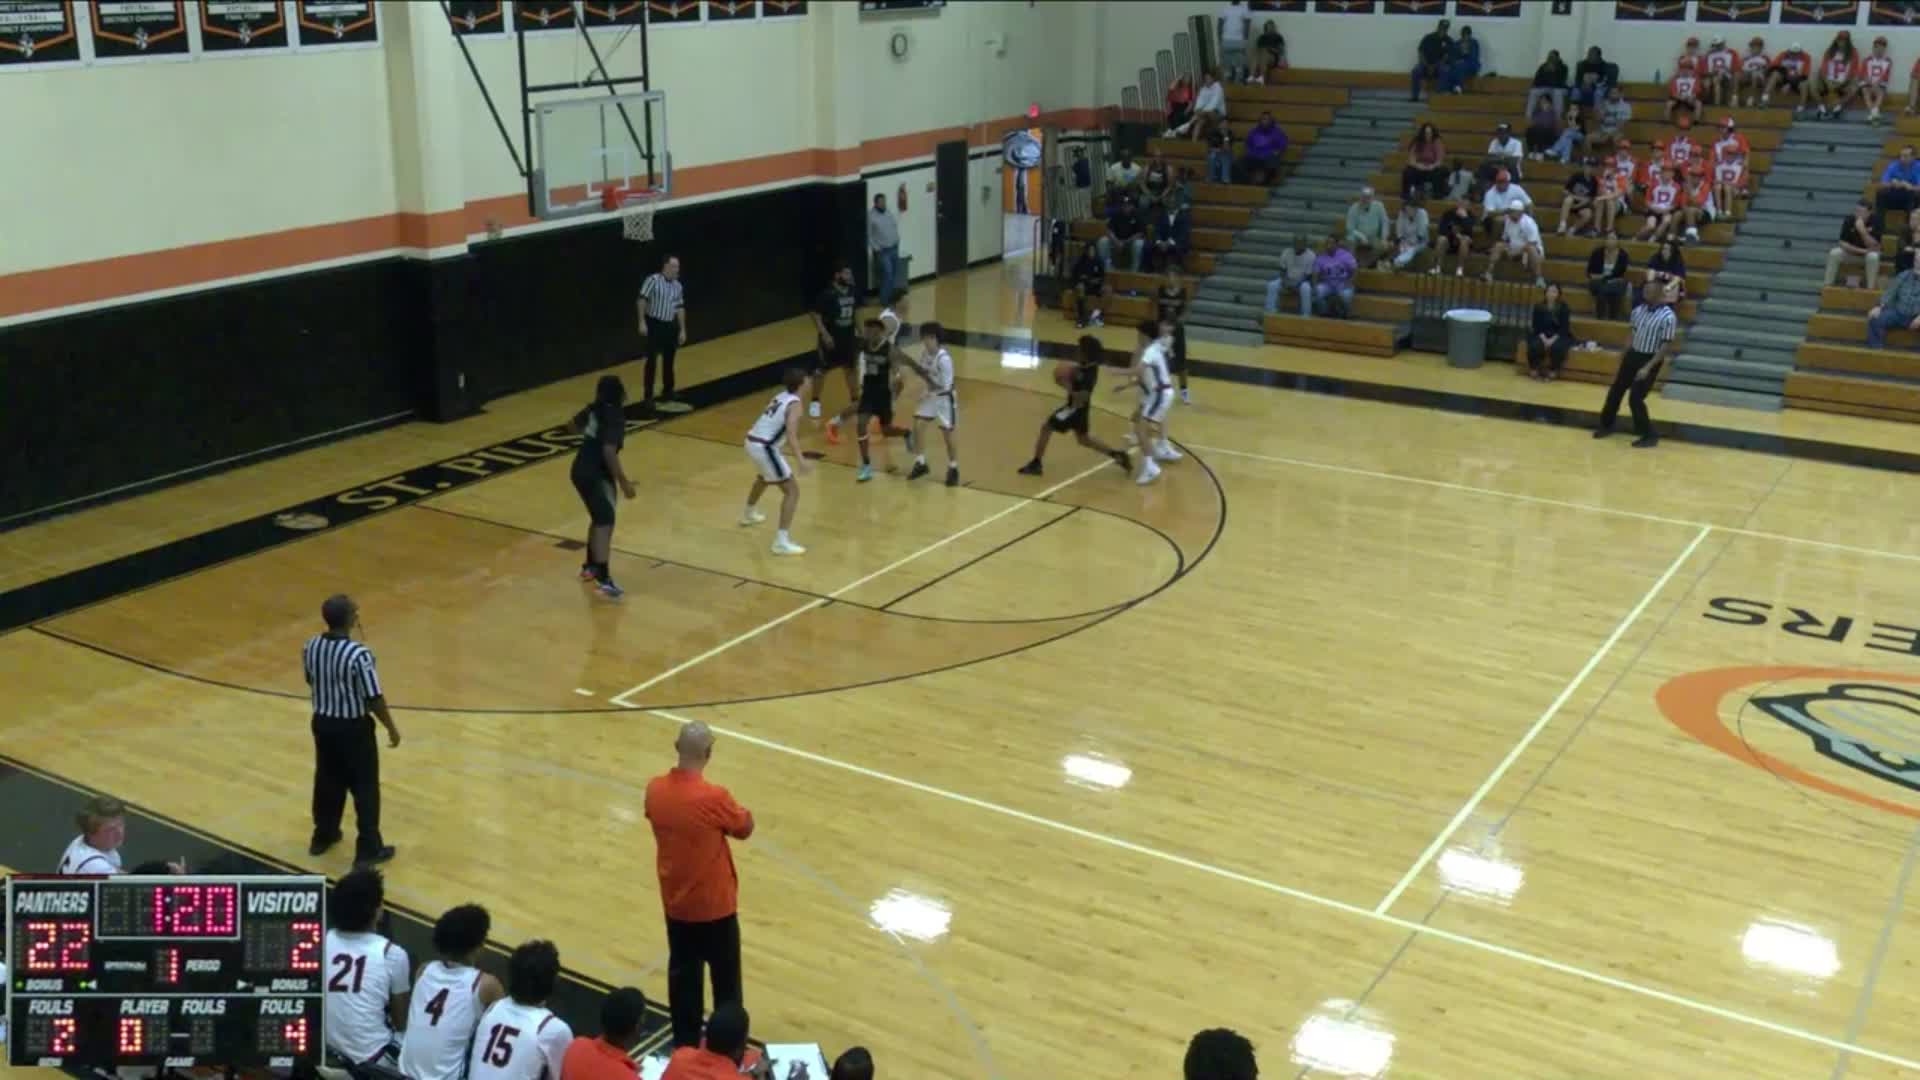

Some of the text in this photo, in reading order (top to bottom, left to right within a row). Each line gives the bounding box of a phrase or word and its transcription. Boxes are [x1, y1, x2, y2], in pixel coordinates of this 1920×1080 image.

[337, 475, 452, 511] ST.
[443, 425, 586, 477] PIUS
[327, 953, 367, 994] 21
[424, 988, 450, 1027] 4
[482, 1023, 521, 1068] 15
